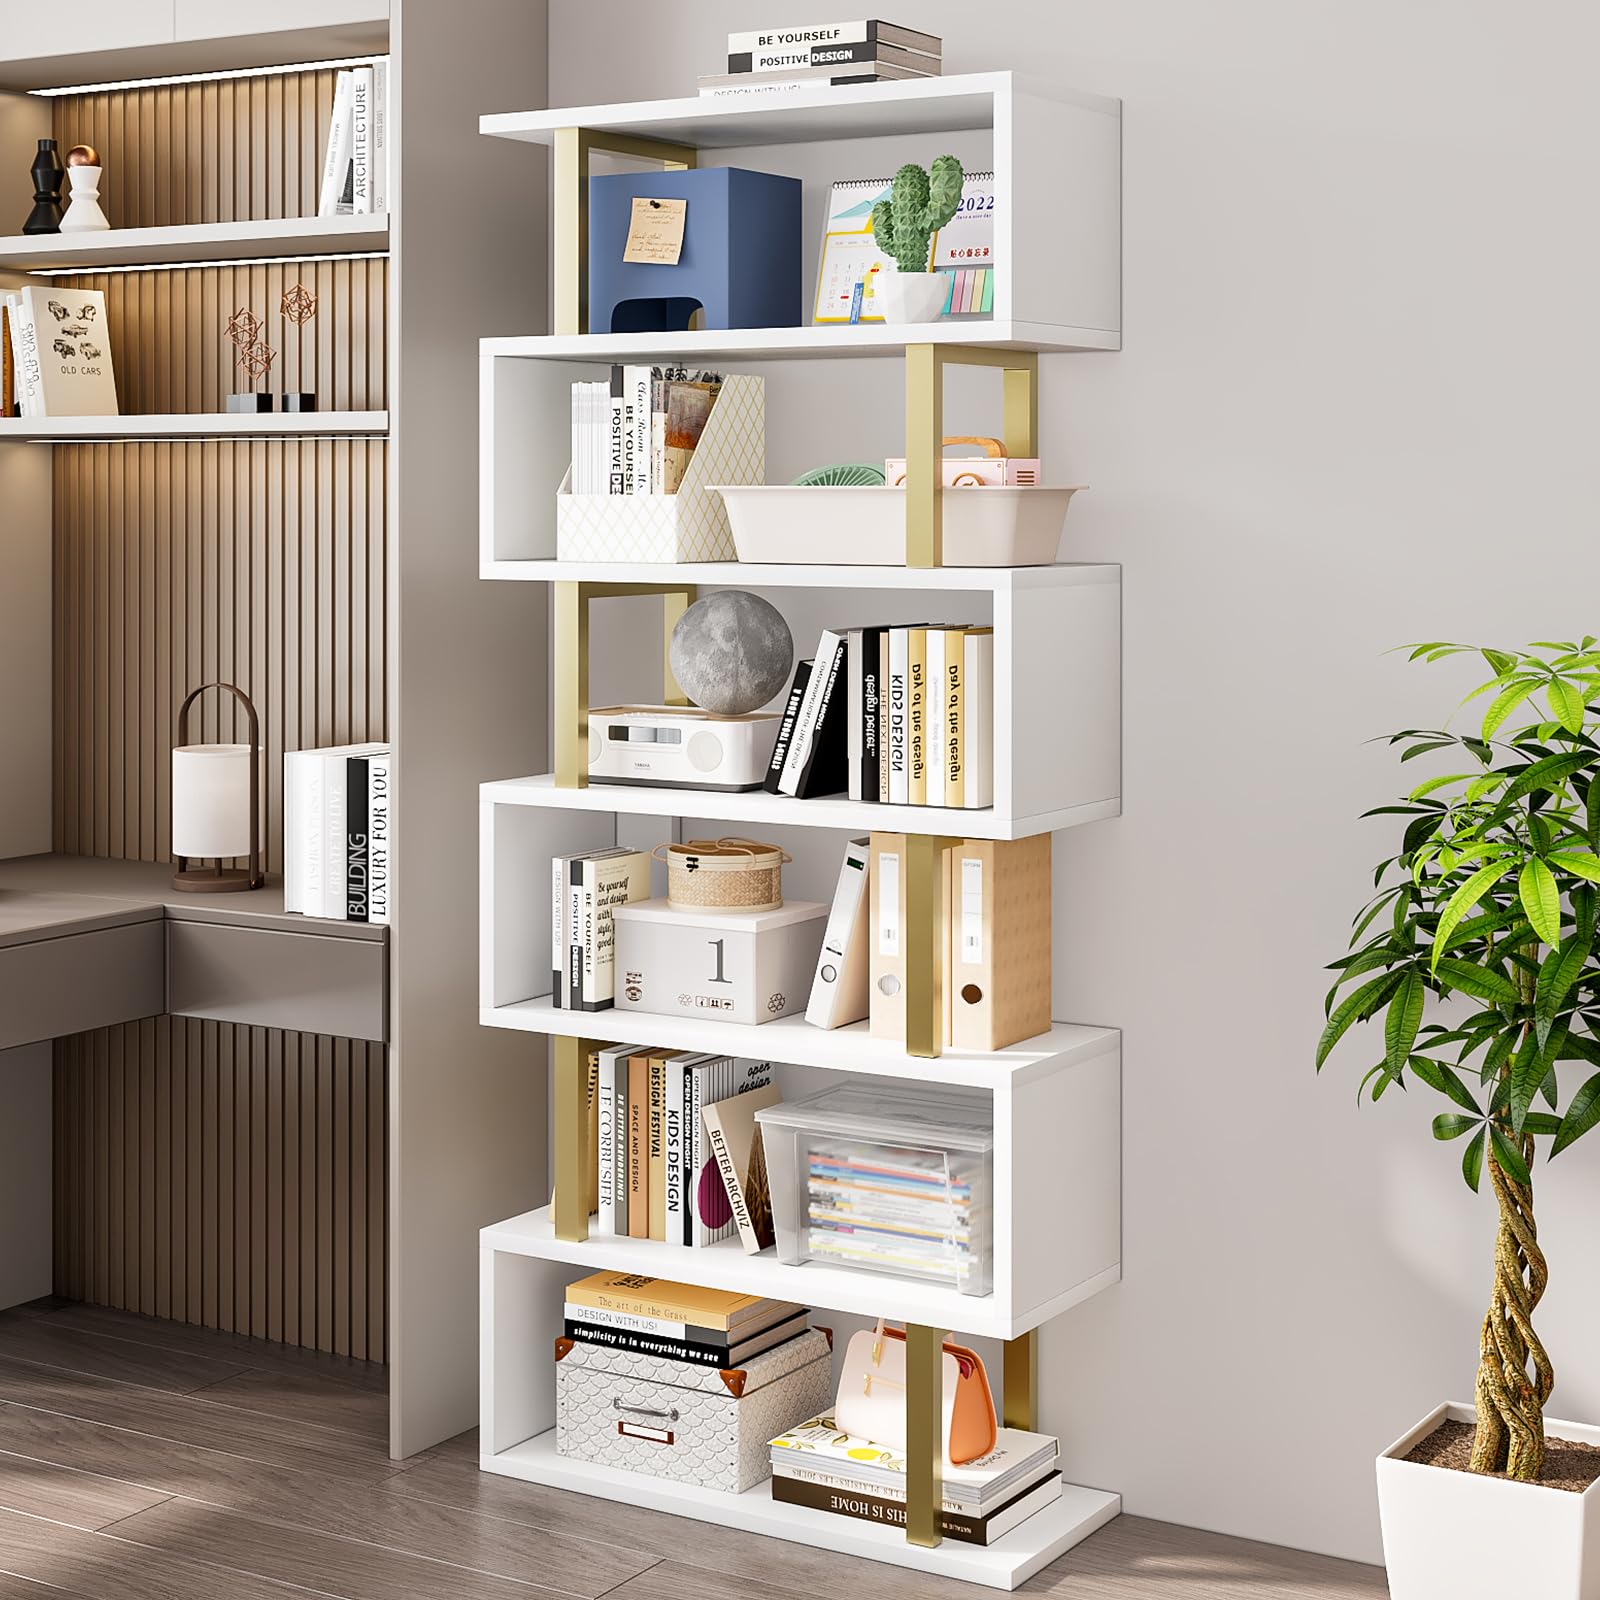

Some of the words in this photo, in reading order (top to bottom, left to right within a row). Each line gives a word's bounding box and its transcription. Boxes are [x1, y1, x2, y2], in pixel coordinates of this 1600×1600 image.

[758, 36, 773, 46] BE
[777, 29, 840, 44] YOURSELF
[760, 54, 809, 67] POSITIVE
[811, 50, 853, 63] DESIGN
[356, 83, 366, 198] ARCHITECTURE
[956, 196, 994, 212] 2022
[60, 365, 77, 374] OLD
[81, 366, 101, 376] CARS
[625, 405, 633, 424] BE
[612, 408, 621, 470] POSITIVE
[625, 430, 633, 495] YOURSE
[372, 767, 387, 800] YOU
[372, 807, 387, 841] FOR
[349, 833, 367, 916] BUILDING
[372, 846, 387, 916] LUXURY
[598, 882, 605, 893] Be
[606, 876, 630, 893] yourself
[585, 893, 592, 908] BE
[597, 896, 609, 907] and
[609, 893, 629, 905] design
[597, 936, 611, 951] good
[708, 938, 733, 984] 1
[747, 1063, 771, 1079] open
[601, 1086, 612, 1107] LE
[651, 1067, 660, 1107] DESIGN
[617, 1093, 624, 1105] BE
[651, 1111, 660, 1158] FESTIVAL
[668, 1110, 679, 1147] KIDS
[601, 1111, 612, 1206] CORBUSIER
[668, 1152, 679, 1212] DESIGN
[711, 1129, 732, 1175] BETTER
[725, 1177, 750, 1230] ARCHVIZ
[598, 1296, 613, 1307] The
[616, 1301, 630, 1311] art
[634, 1304, 644, 1313] of
[648, 1306, 661, 1317] the
[577, 1308, 612, 1323] DESIGN
[614, 1316, 639, 1328] WITH
[641, 1320, 658, 1331] US!
[574, 1327, 617, 1343] simplicity
[618, 1335, 627, 1346] is
[629, 1337, 638, 1347] in
[640, 1340, 687, 1358] everything
[688, 1350, 701, 1360] we
[703, 1352, 719, 1363] see
[831, 1495, 869, 1515] HOME
[872, 1504, 884, 1519] IS
[886, 1507, 907, 1524] HIS
